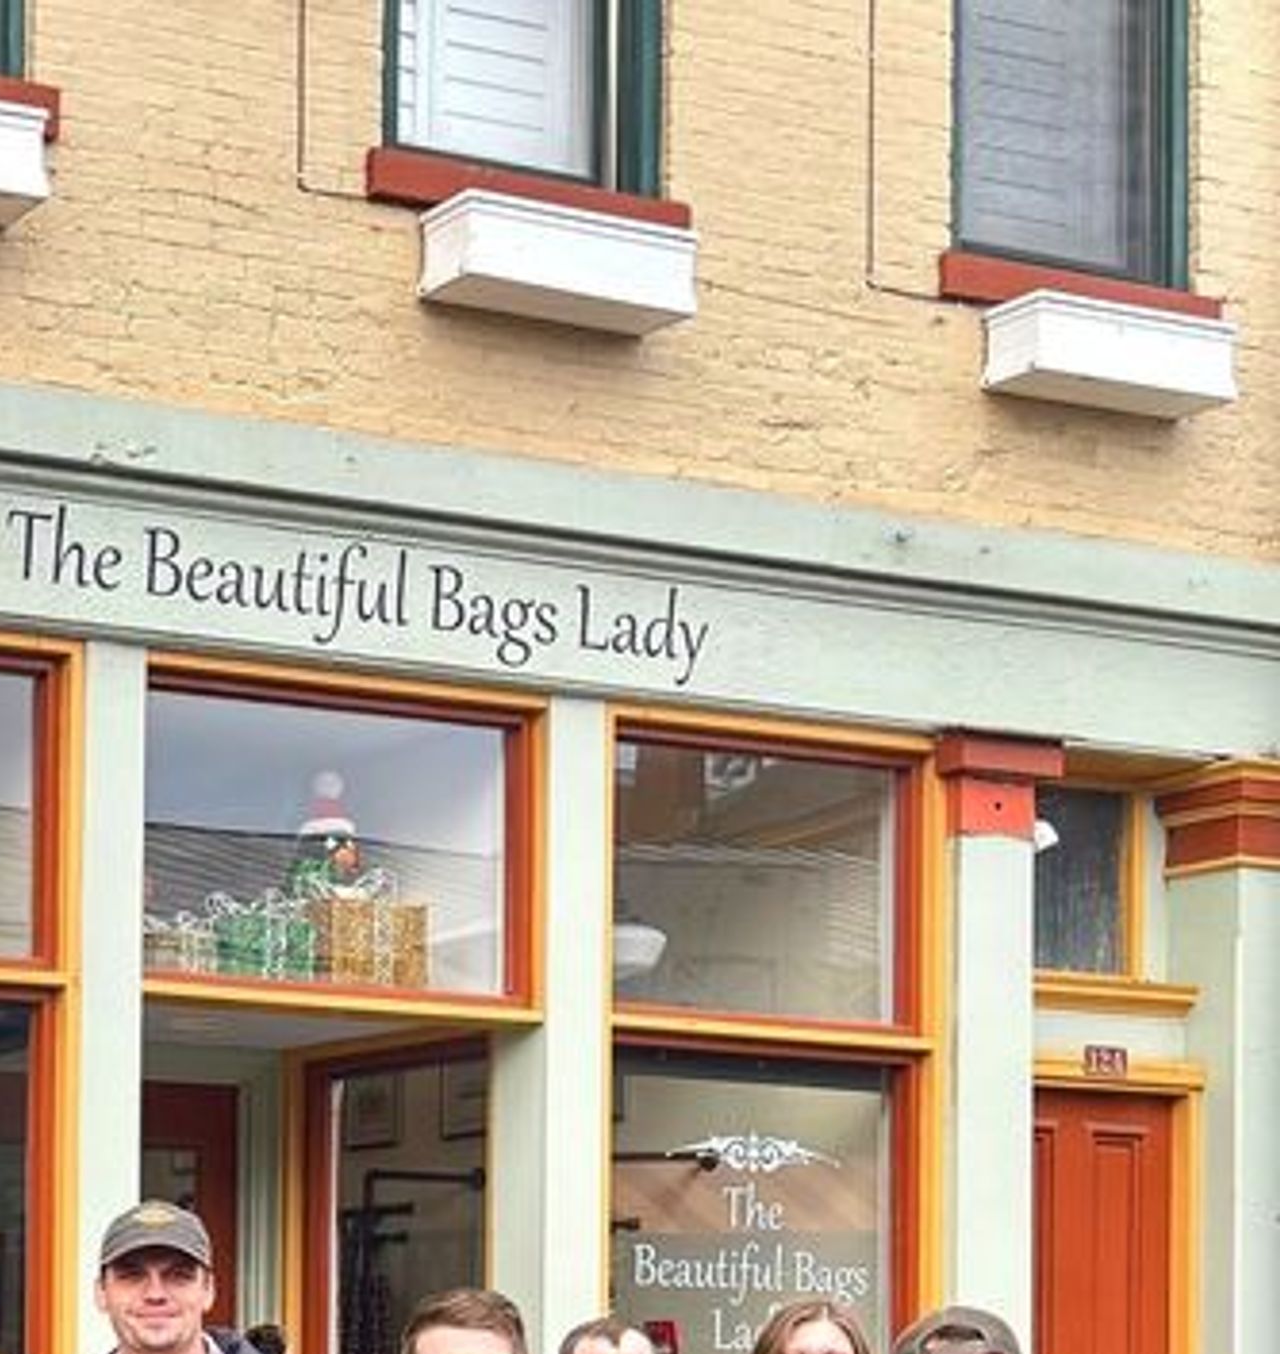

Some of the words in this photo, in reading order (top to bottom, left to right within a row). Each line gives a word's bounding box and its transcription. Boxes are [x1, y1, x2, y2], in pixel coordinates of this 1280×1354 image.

[7, 505, 123, 592] The
[143, 525, 410, 646] Beautiful
[427, 563, 559, 669] Bags
[575, 583, 712, 687] Lady
[722, 1182, 786, 1231] The
[633, 1240, 785, 1305] Beautiful
[792, 1250, 870, 1303] Bags
